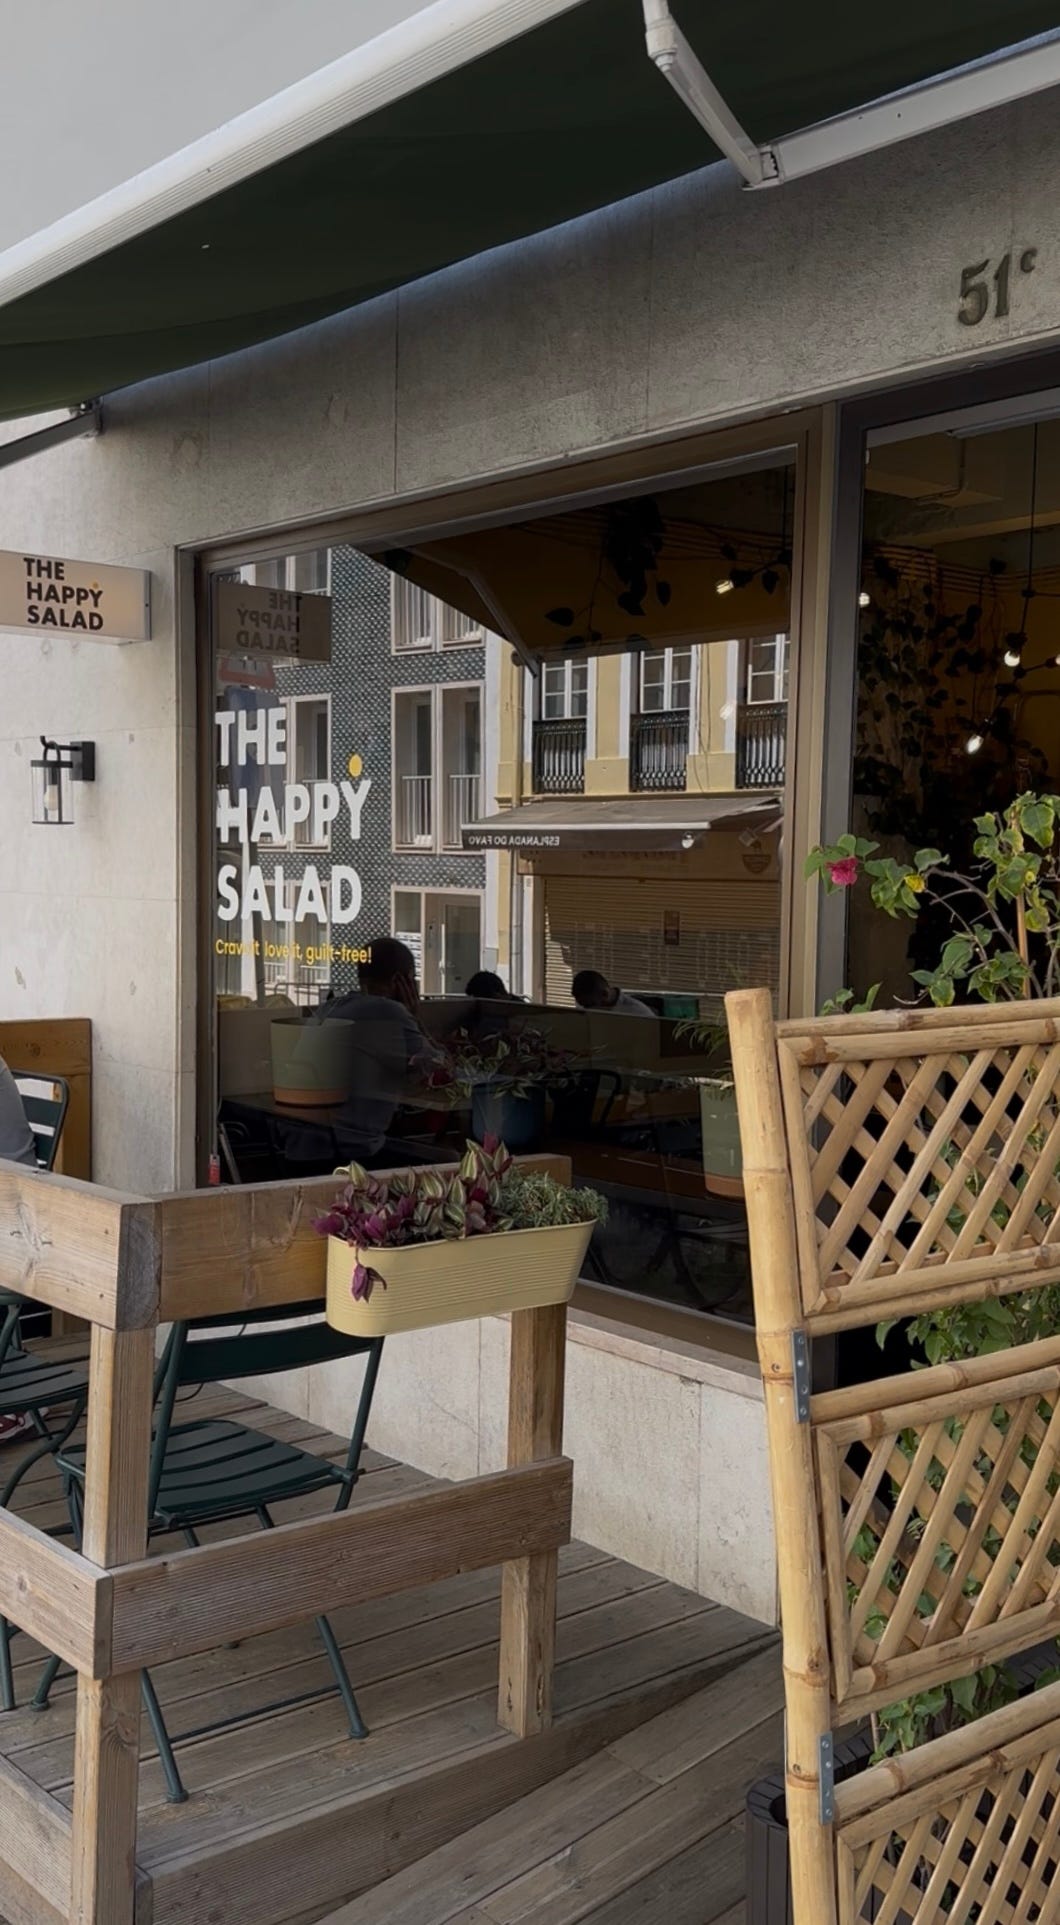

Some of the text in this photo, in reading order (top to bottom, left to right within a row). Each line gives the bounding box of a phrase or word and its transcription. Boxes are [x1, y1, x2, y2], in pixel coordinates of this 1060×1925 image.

[23, 557, 65, 581] THE
[26, 581, 104, 608] HAPPY
[27, 605, 104, 631] SALAD
[215, 707, 287, 766] THE
[216, 779, 372, 844] HAPPY
[217, 864, 362, 925] SALAD
[264, 941, 289, 957] love
[306, 943, 372, 965] guilt-free!
